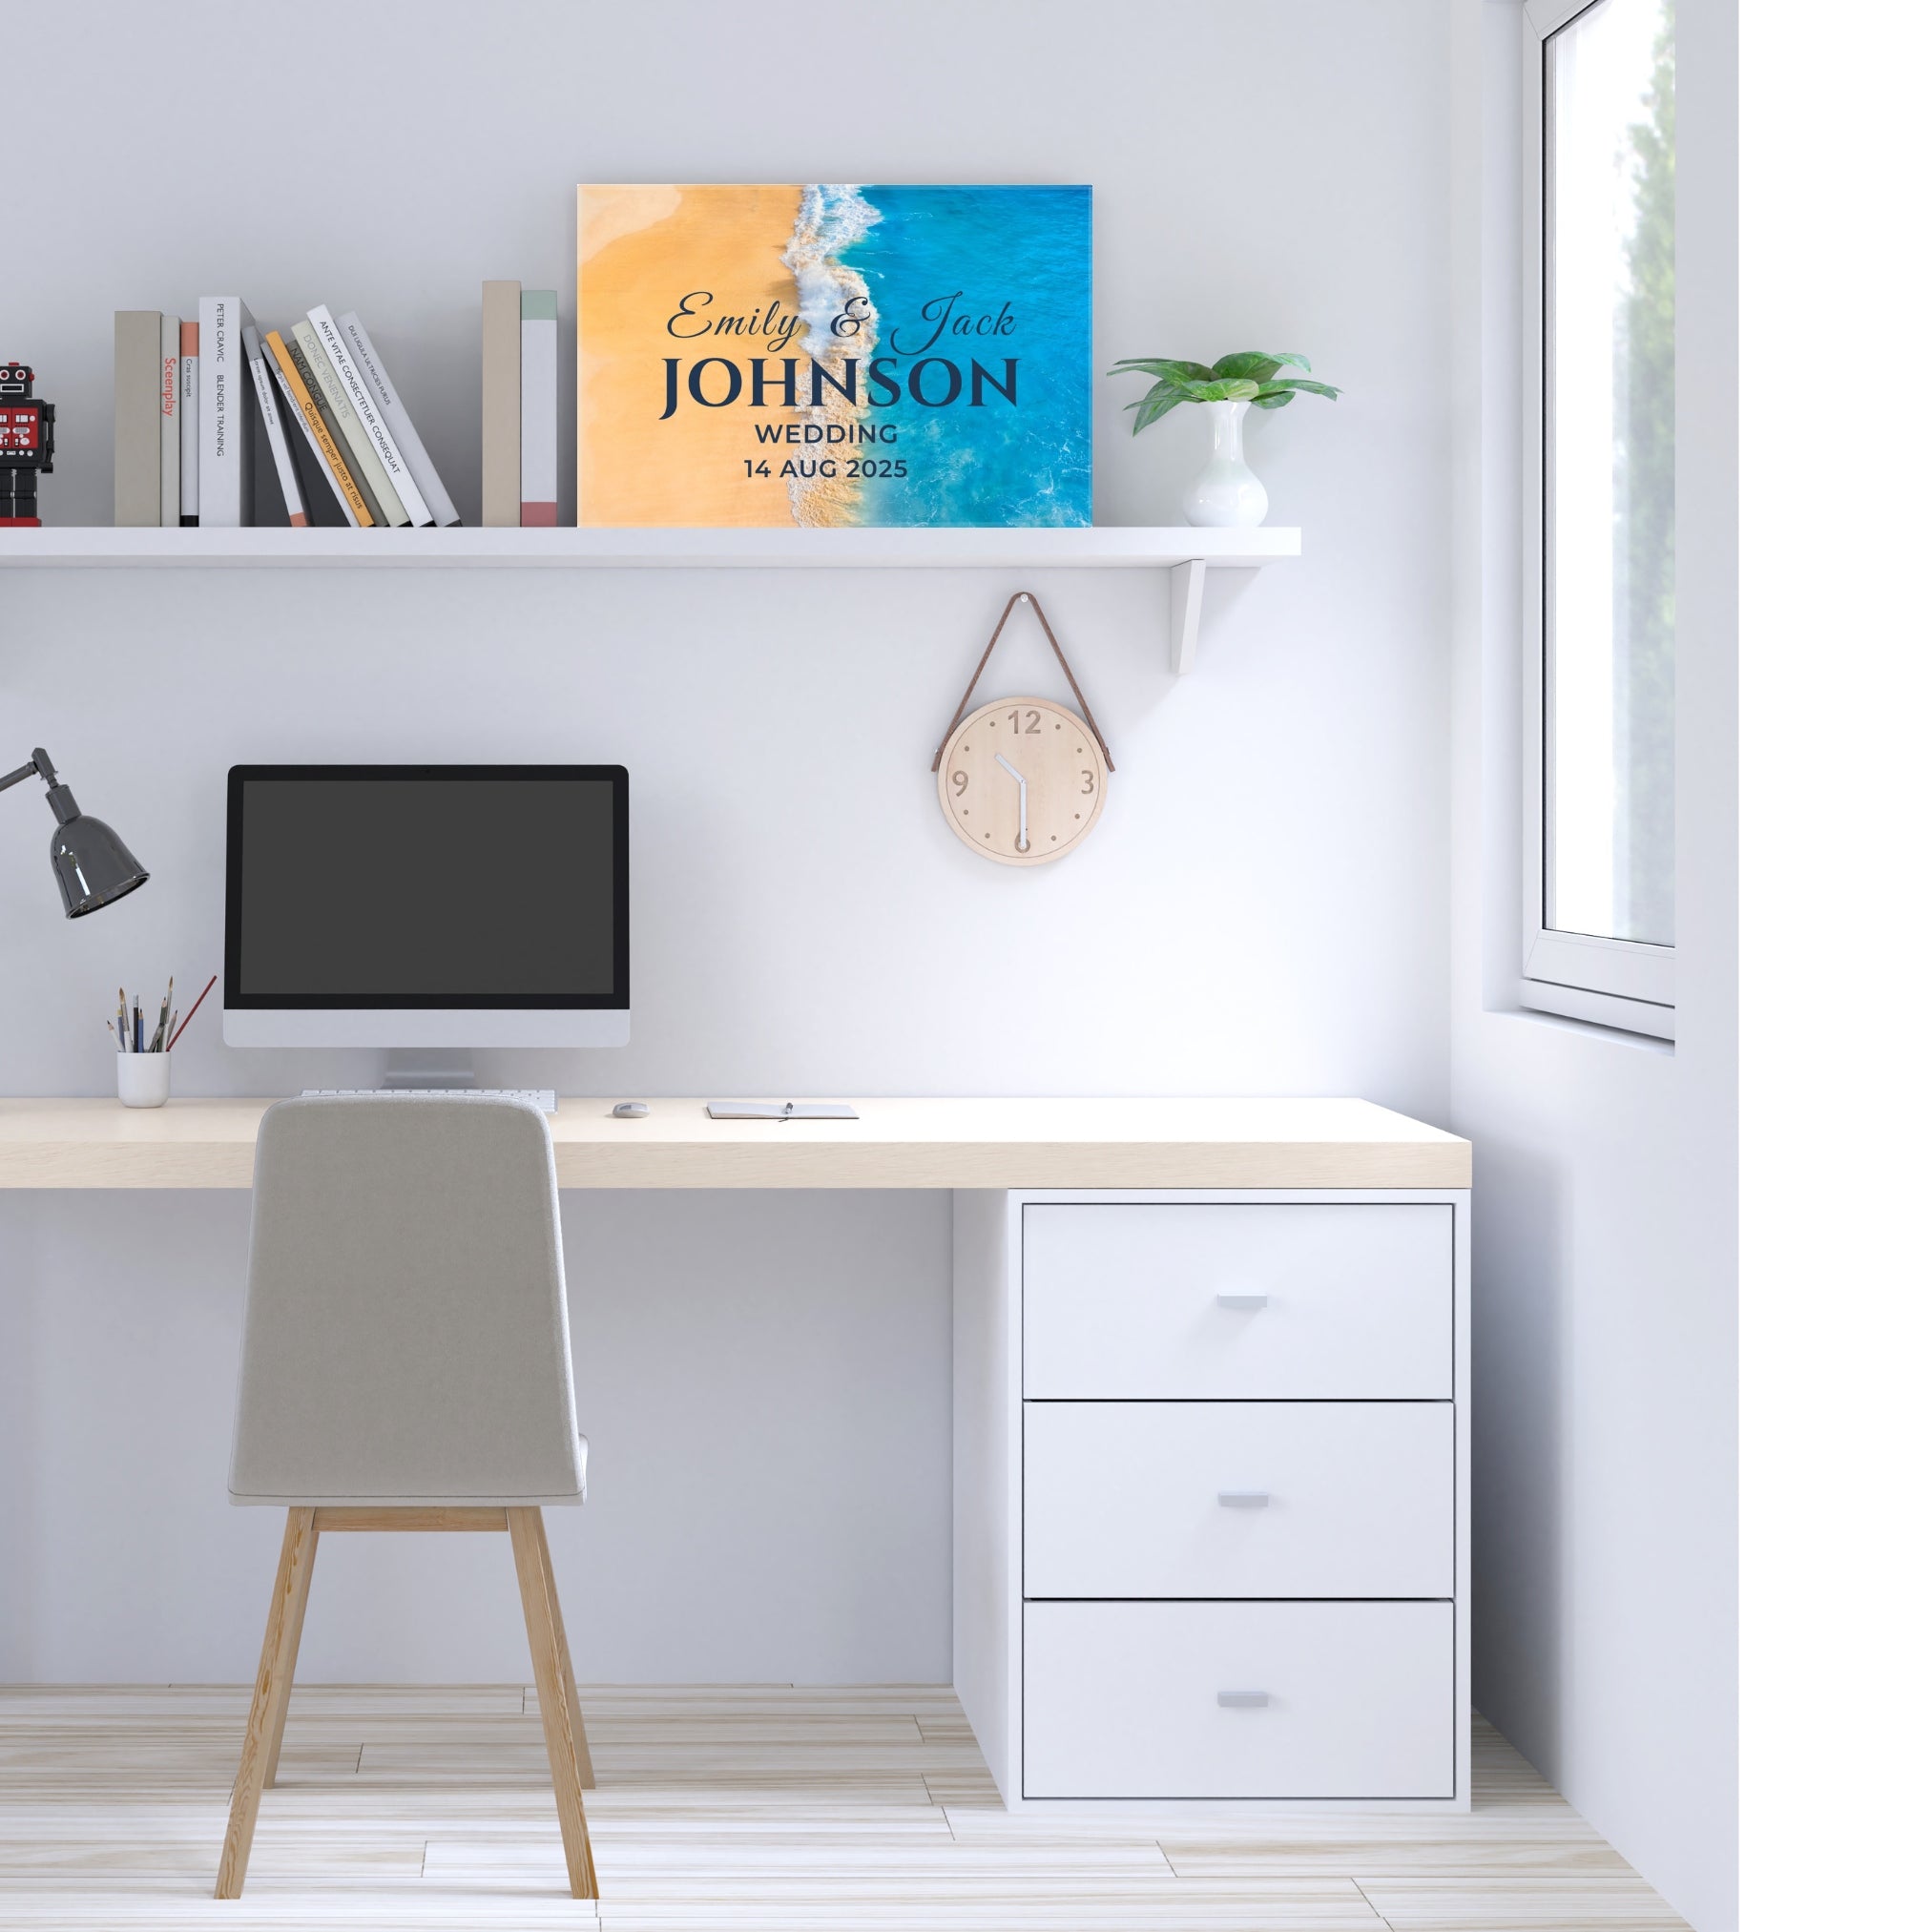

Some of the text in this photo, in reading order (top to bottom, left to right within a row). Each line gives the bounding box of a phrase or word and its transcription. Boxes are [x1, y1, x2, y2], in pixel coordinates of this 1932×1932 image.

[667, 290, 1017, 356] Emily & Jack
[161, 358, 177, 417] Sceenplay
[292, 348, 327, 412] NAM CONGUE
[303, 335, 351, 419] DONEC VENENATIS
[348, 325, 391, 405] DUI LIGULA ULTRICIES PURUS
[658, 358, 1022, 421] JOHNSON
[320, 321, 401, 473] ANTE VITAE CONSECTETUER CONSEQUAT
[305, 402, 323, 433] Quisque
[321, 433, 338, 462] semper
[334, 462, 348, 482] justo
[350, 490, 363, 509] risus
[754, 424, 898, 444] WEDDING
[744, 459, 908, 478] 14 AUG 2025
[1008, 710, 1041, 734] 12
[952, 770, 969, 797] 9
[1080, 770, 1094, 795] 3
